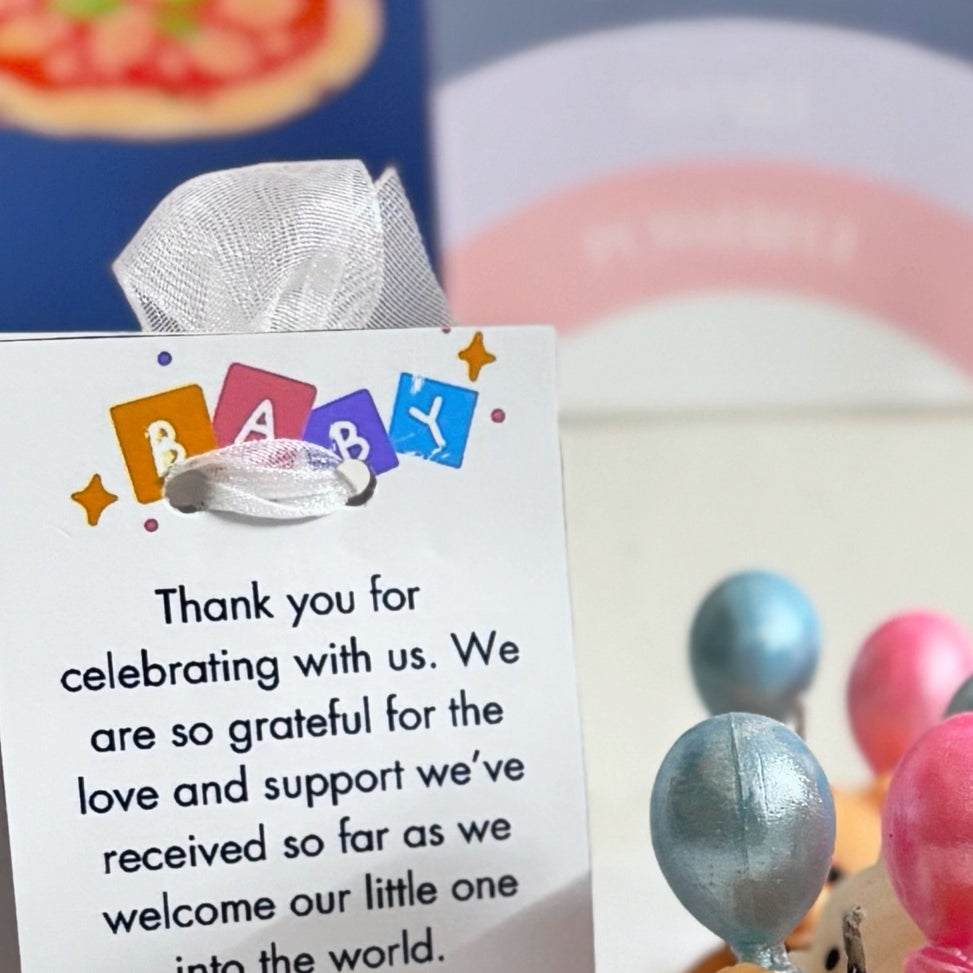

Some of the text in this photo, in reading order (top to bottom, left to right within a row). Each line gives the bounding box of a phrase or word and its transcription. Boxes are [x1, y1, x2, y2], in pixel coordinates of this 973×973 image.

[146, 396, 446, 479] BABY
[154, 574, 420, 628] Thank you for
[60, 630, 519, 692] celebrating with us. We
[91, 689, 503, 754] are so grateful for the
[78, 750, 524, 815] love and support we’ve
[104, 816, 511, 874] received so far as we
[102, 870, 518, 934] welcome our little one
[329, 927, 444, 972] world.
